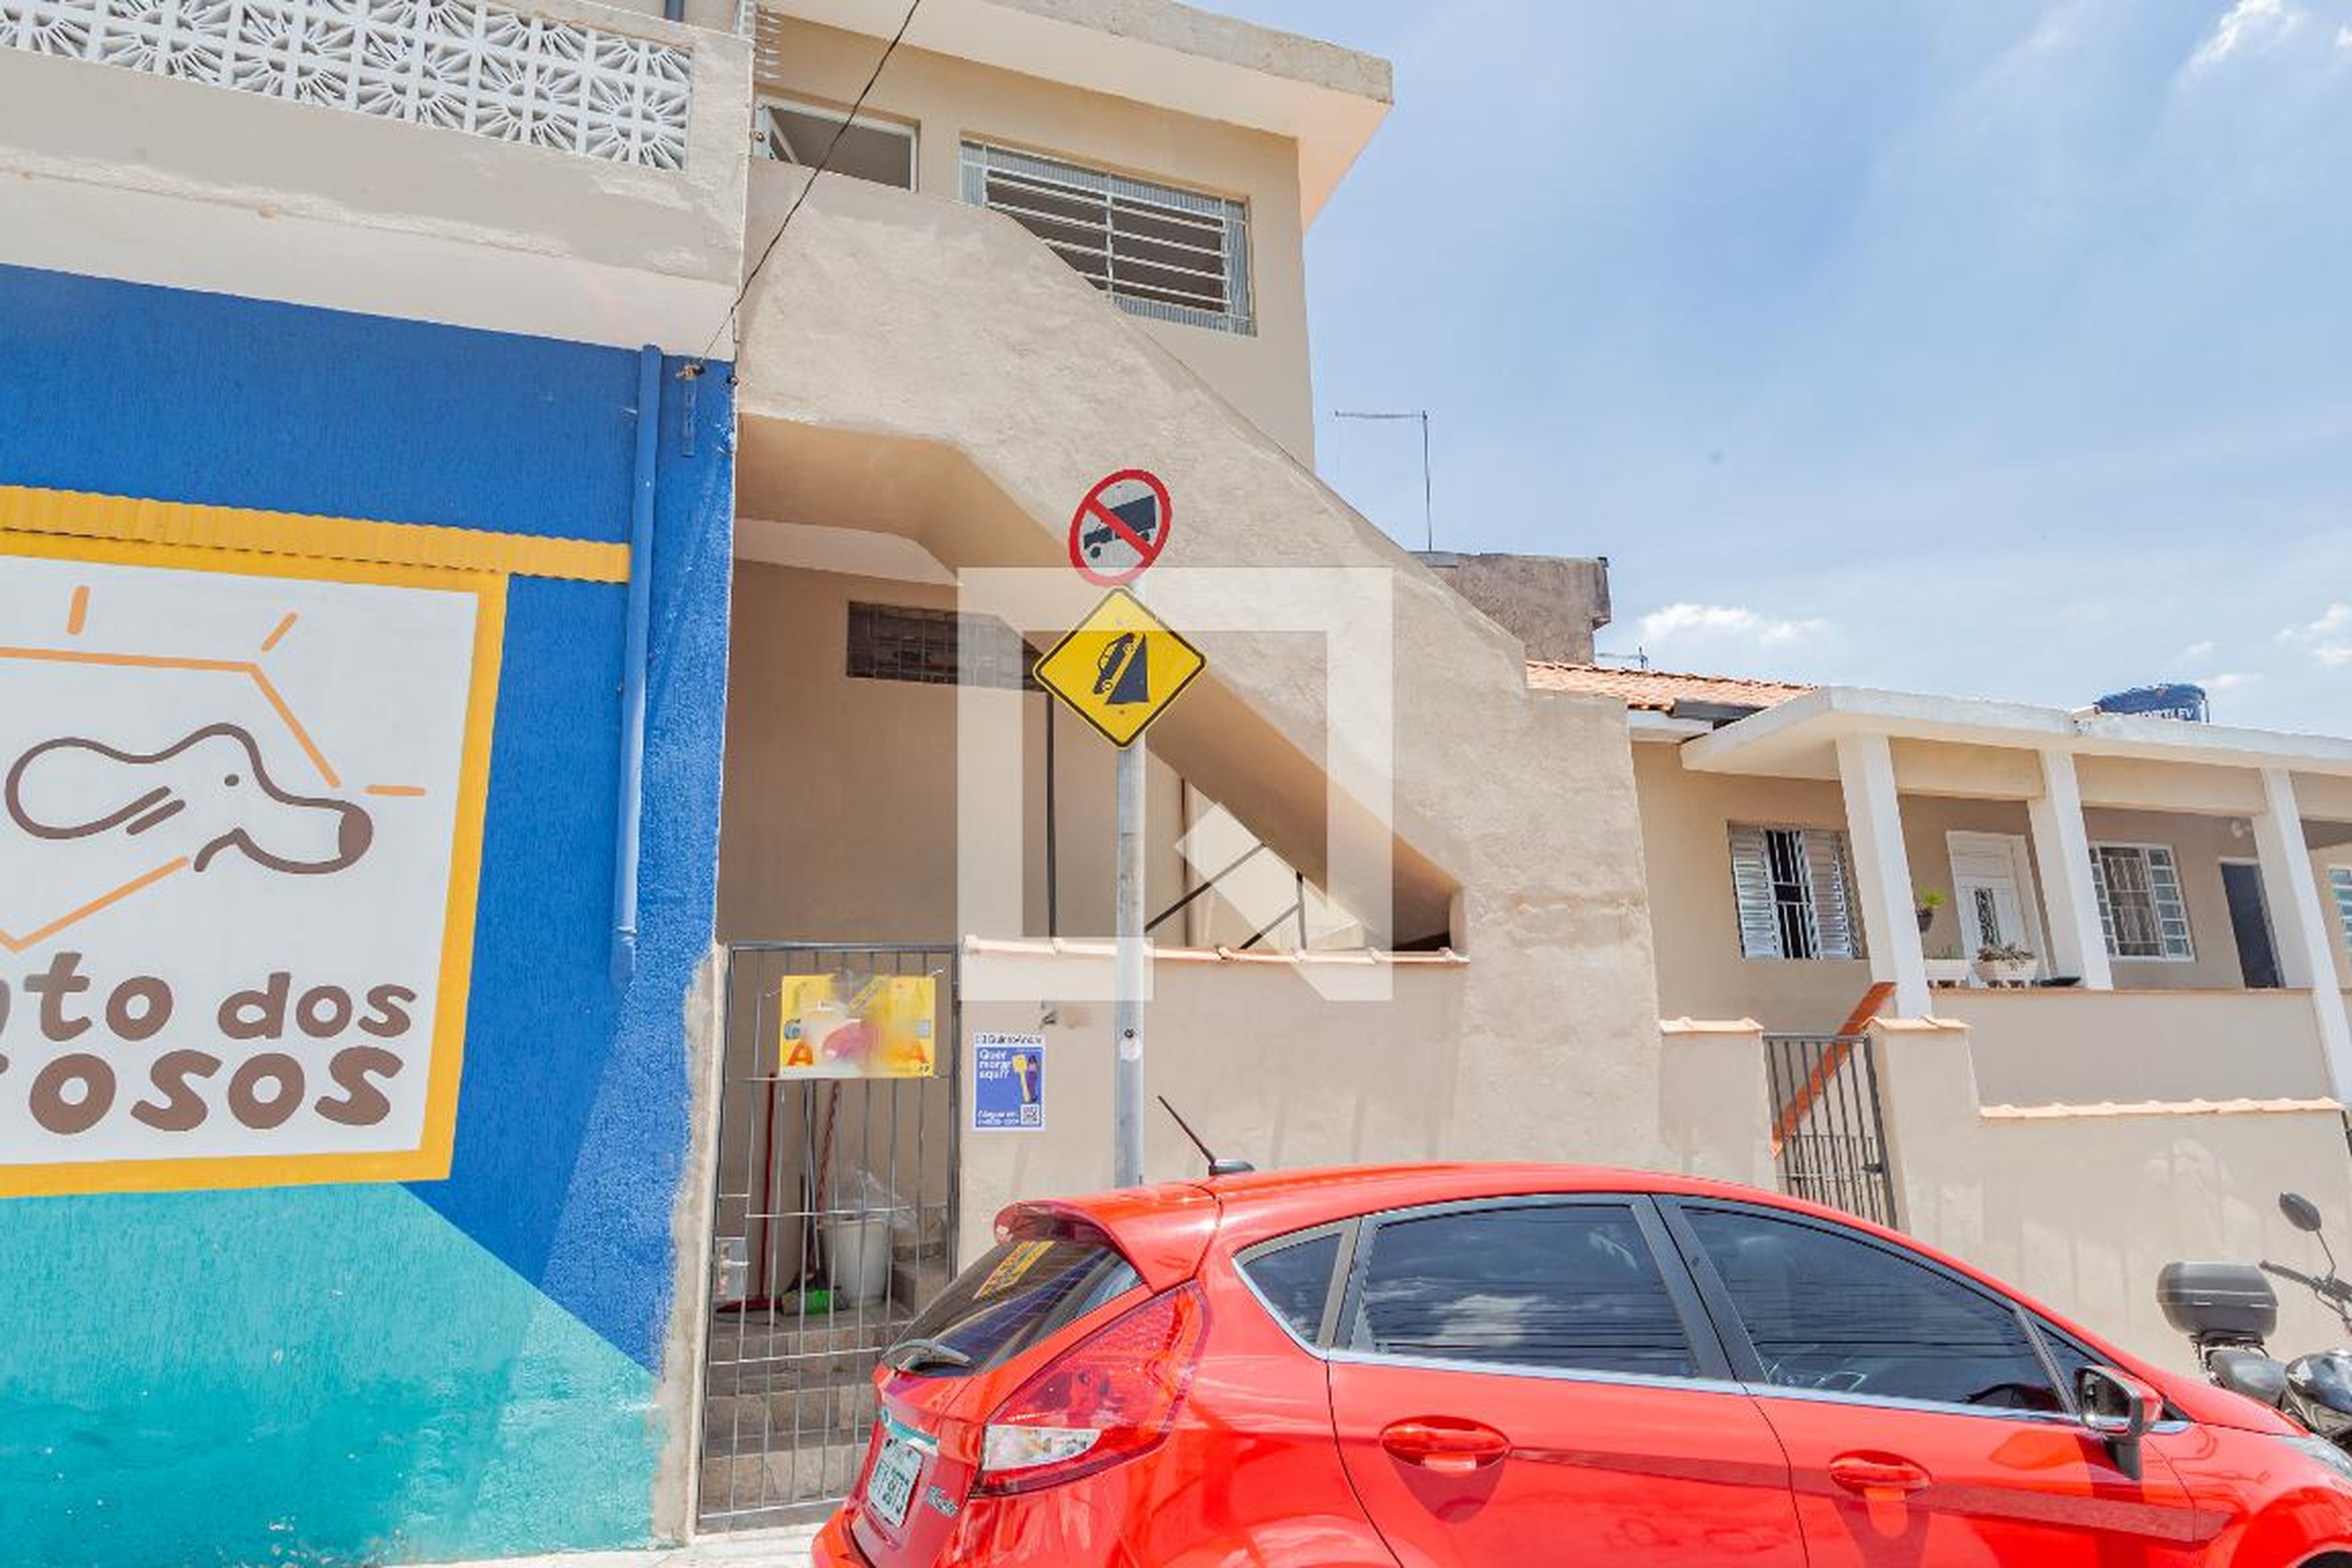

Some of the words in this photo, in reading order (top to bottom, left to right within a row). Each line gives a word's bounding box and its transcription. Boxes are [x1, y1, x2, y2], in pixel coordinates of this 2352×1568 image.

[0, 952, 173, 1041] to
[217, 971, 417, 1039] dos
[0, 1046, 404, 1134] osos
